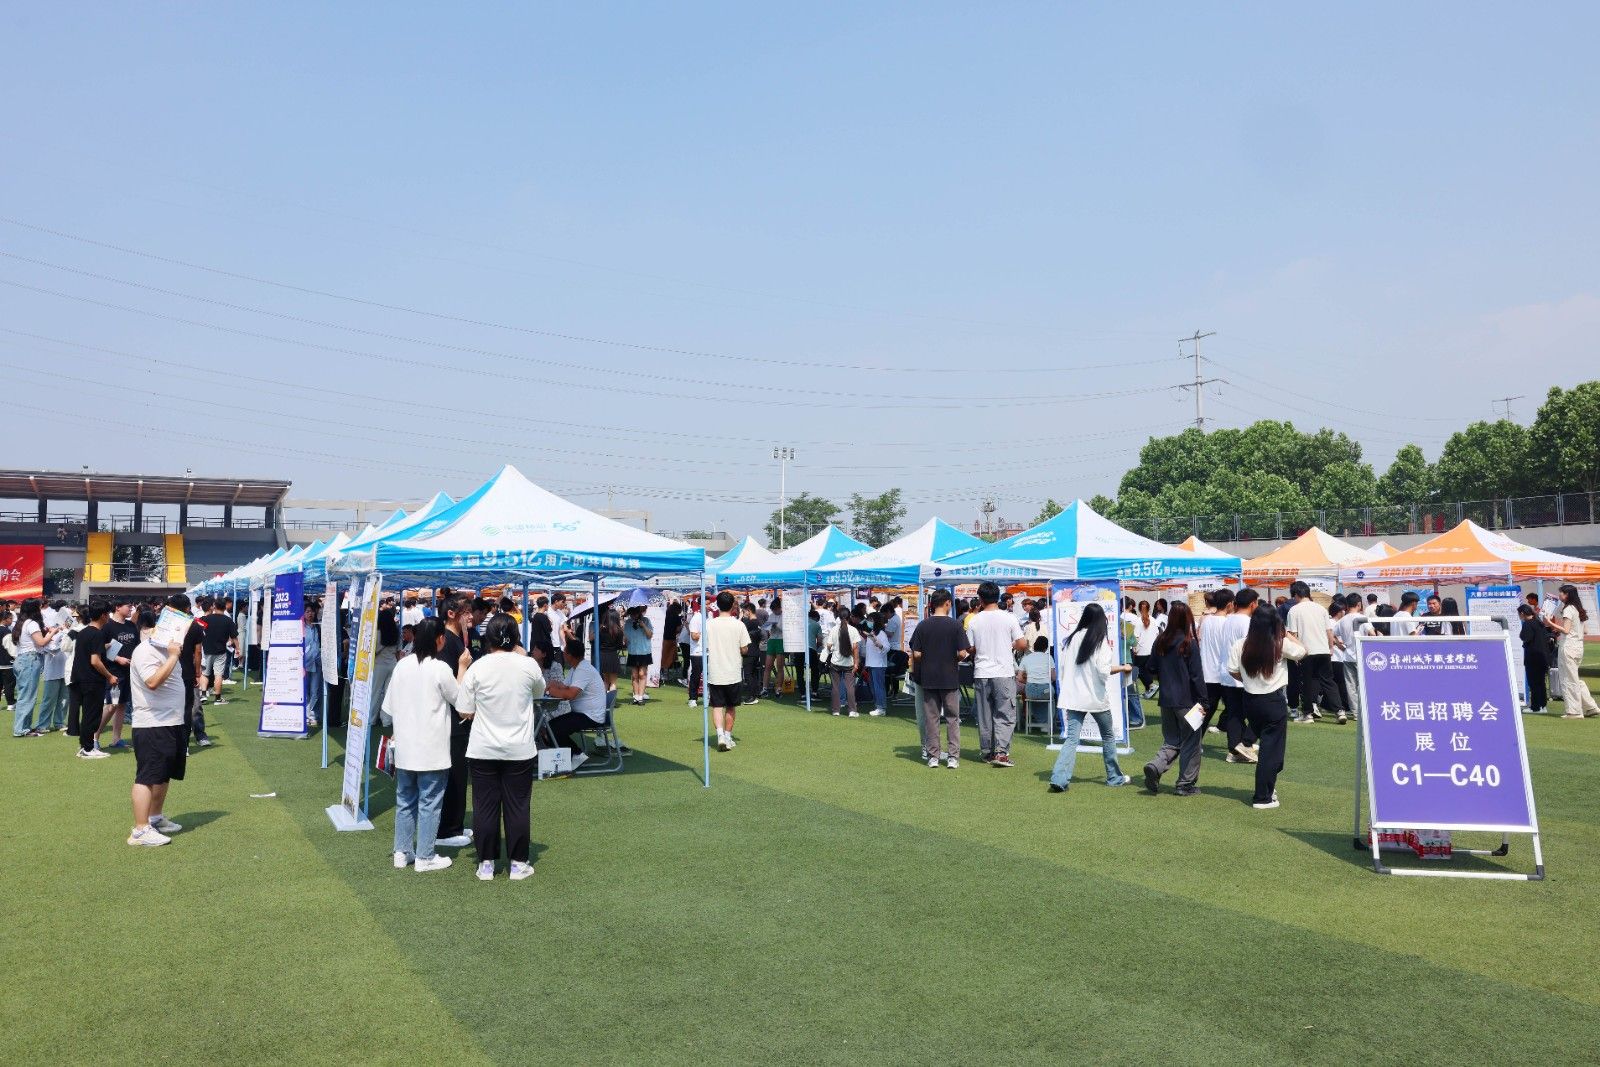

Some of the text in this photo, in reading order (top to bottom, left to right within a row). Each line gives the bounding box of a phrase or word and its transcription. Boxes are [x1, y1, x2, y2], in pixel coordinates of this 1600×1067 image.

[1380, 701, 1500, 722] 校园招聘会
